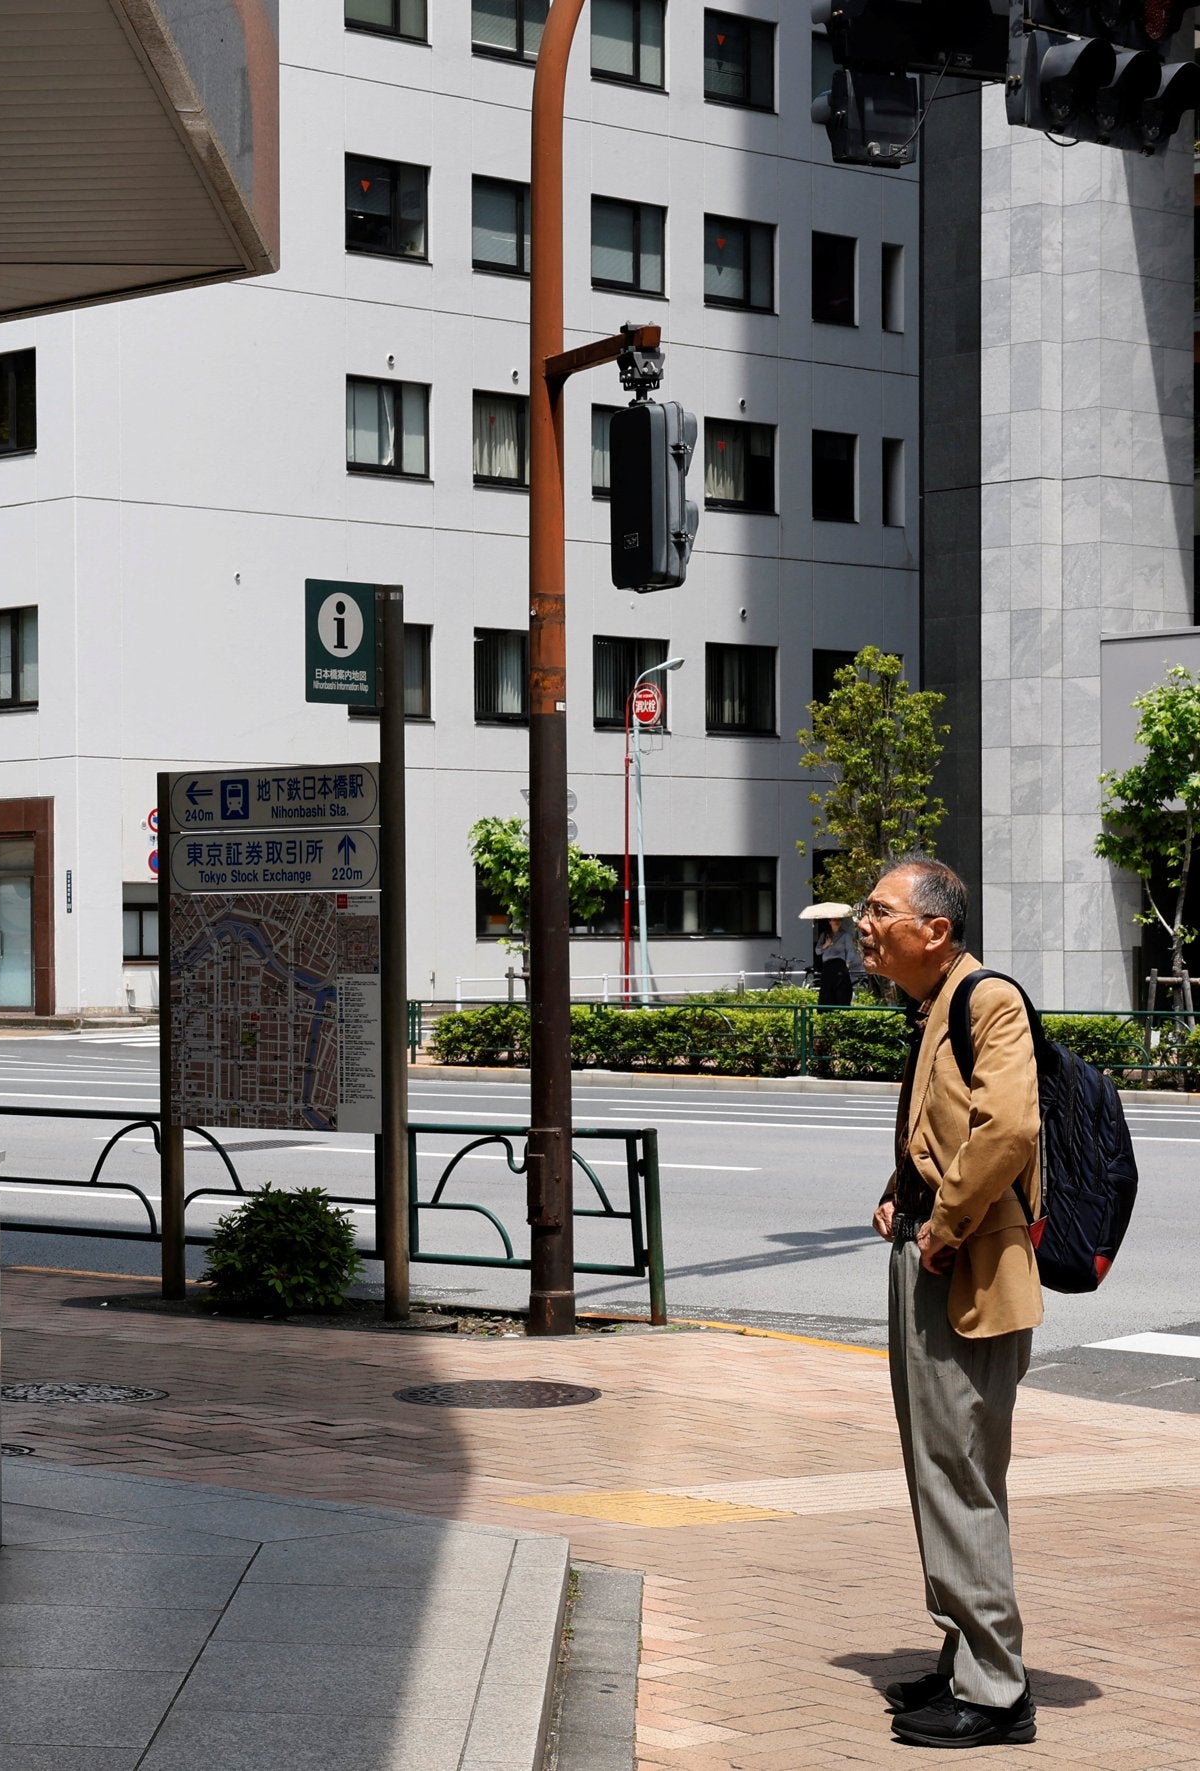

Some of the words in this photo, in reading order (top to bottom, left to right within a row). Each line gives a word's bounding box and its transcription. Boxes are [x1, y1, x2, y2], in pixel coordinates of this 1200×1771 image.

[257, 775, 364, 801] 地下鉄日本橋駅
[185, 810, 214, 822] 240m
[271, 805, 326, 819] Nihonbashi
[329, 803, 349, 817] Sta.
[186, 840, 324, 866] 東京証券取引所
[199, 871, 227, 885] Tokyo
[231, 870, 259, 883] Stock
[262, 869, 312, 884] Exchange
[332, 868, 363, 881] 220m
